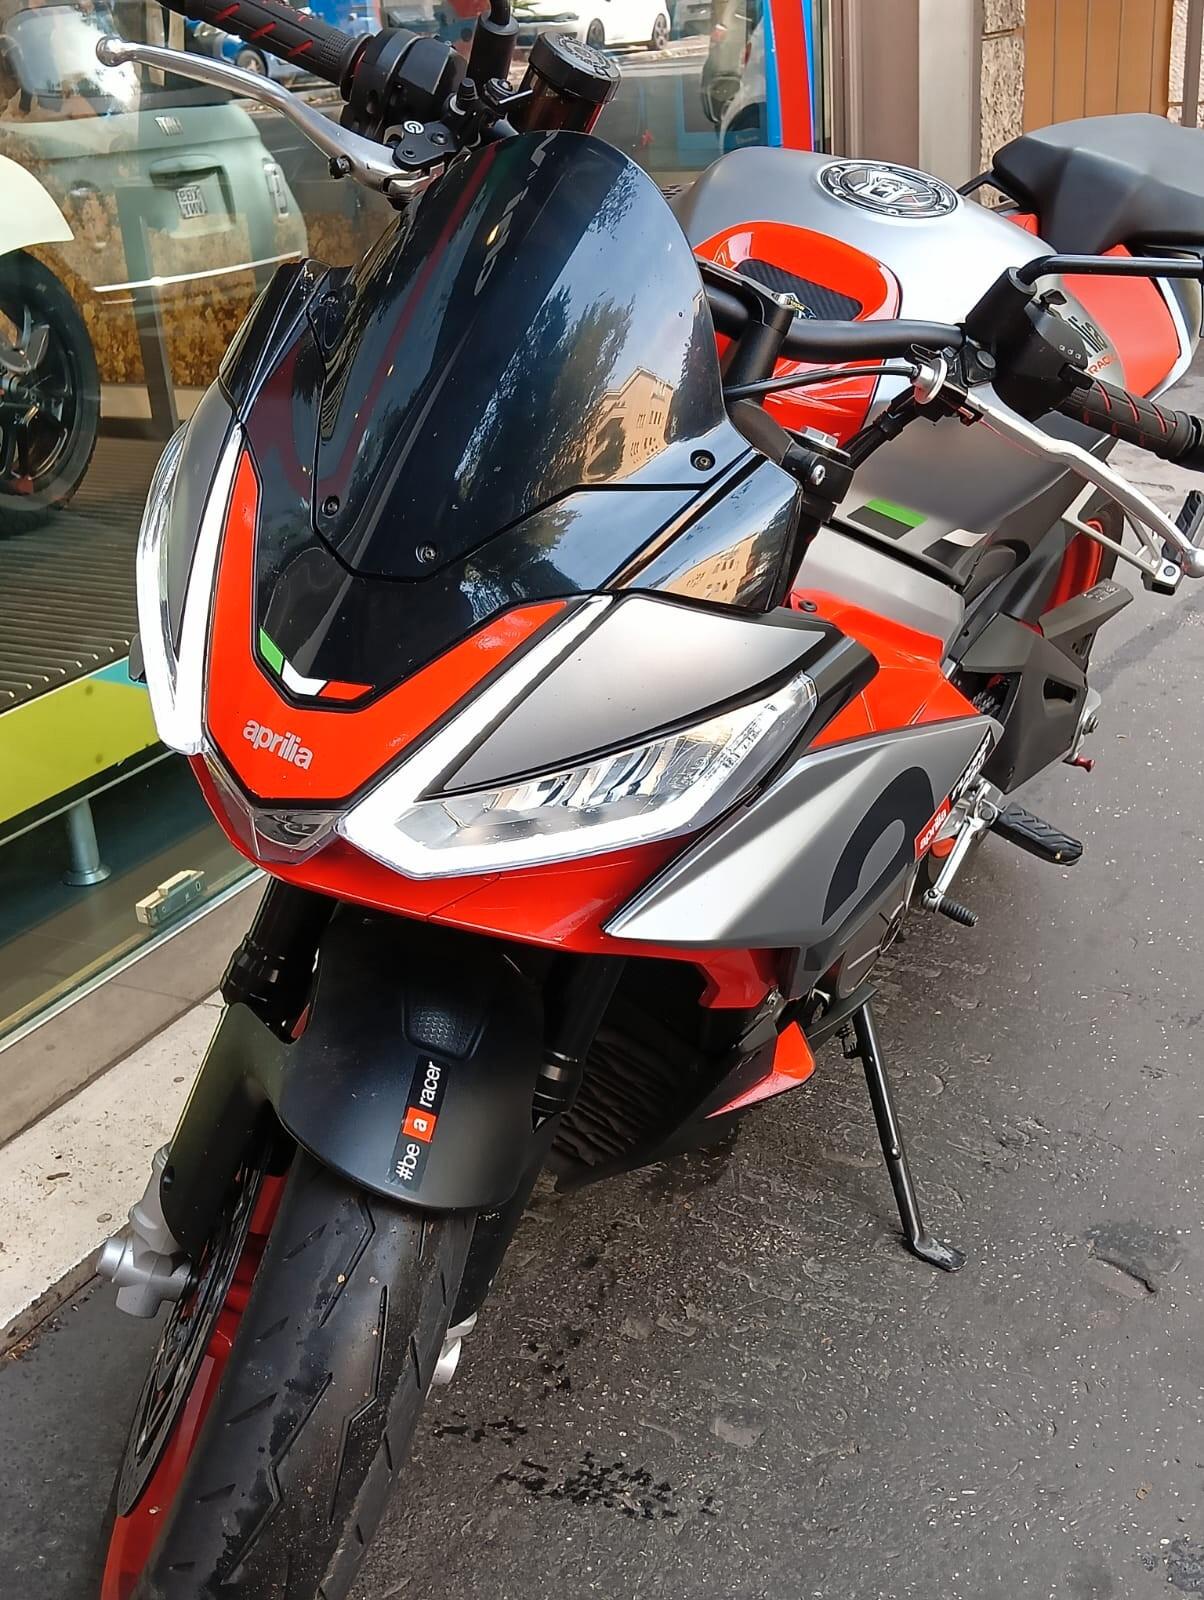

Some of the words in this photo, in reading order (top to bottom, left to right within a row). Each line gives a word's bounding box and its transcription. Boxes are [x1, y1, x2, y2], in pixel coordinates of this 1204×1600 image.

[242, 719, 314, 770] aprilia
[418, 1060, 442, 1109] racer
[413, 1118, 429, 1133] a
[395, 1142, 421, 1181] #be
